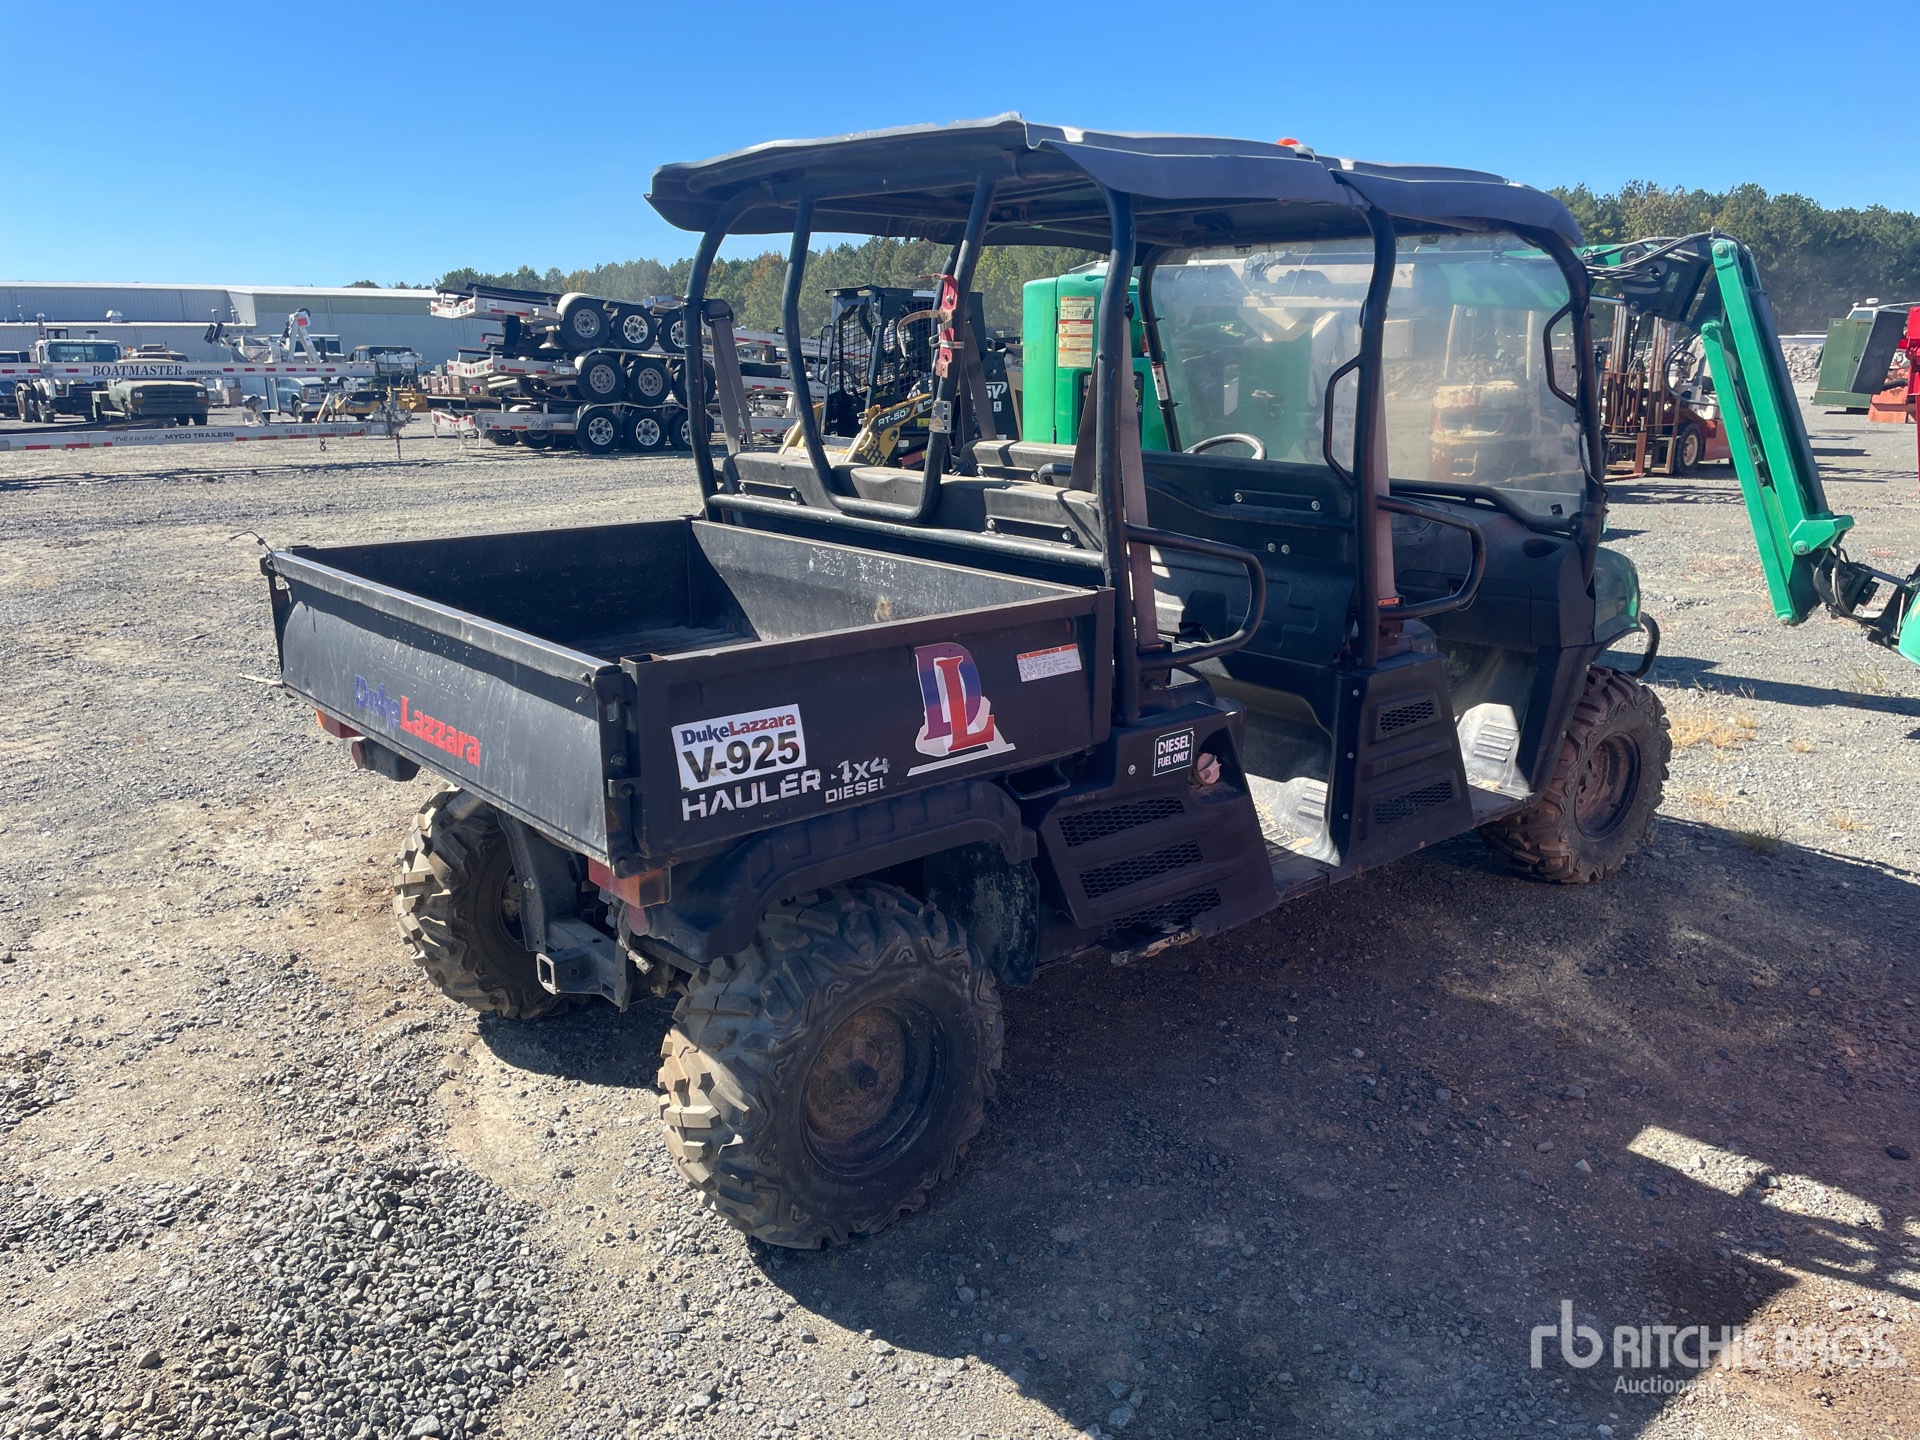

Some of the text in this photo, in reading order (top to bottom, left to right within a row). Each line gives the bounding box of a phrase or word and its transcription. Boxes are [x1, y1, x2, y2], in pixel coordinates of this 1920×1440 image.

[92, 365, 183, 377] BOATMASTER
[878, 408, 906, 427] RT-50
[192, 431, 235, 439] TRAILERS
[680, 714, 796, 746] DukeLazzara
[1157, 735, 1190, 755] DIESEL
[682, 730, 800, 783] V-925
[1157, 751, 1189, 768] FUEL ONLY
[681, 768, 821, 822] HAULER
[825, 777, 886, 804] DIESEL
